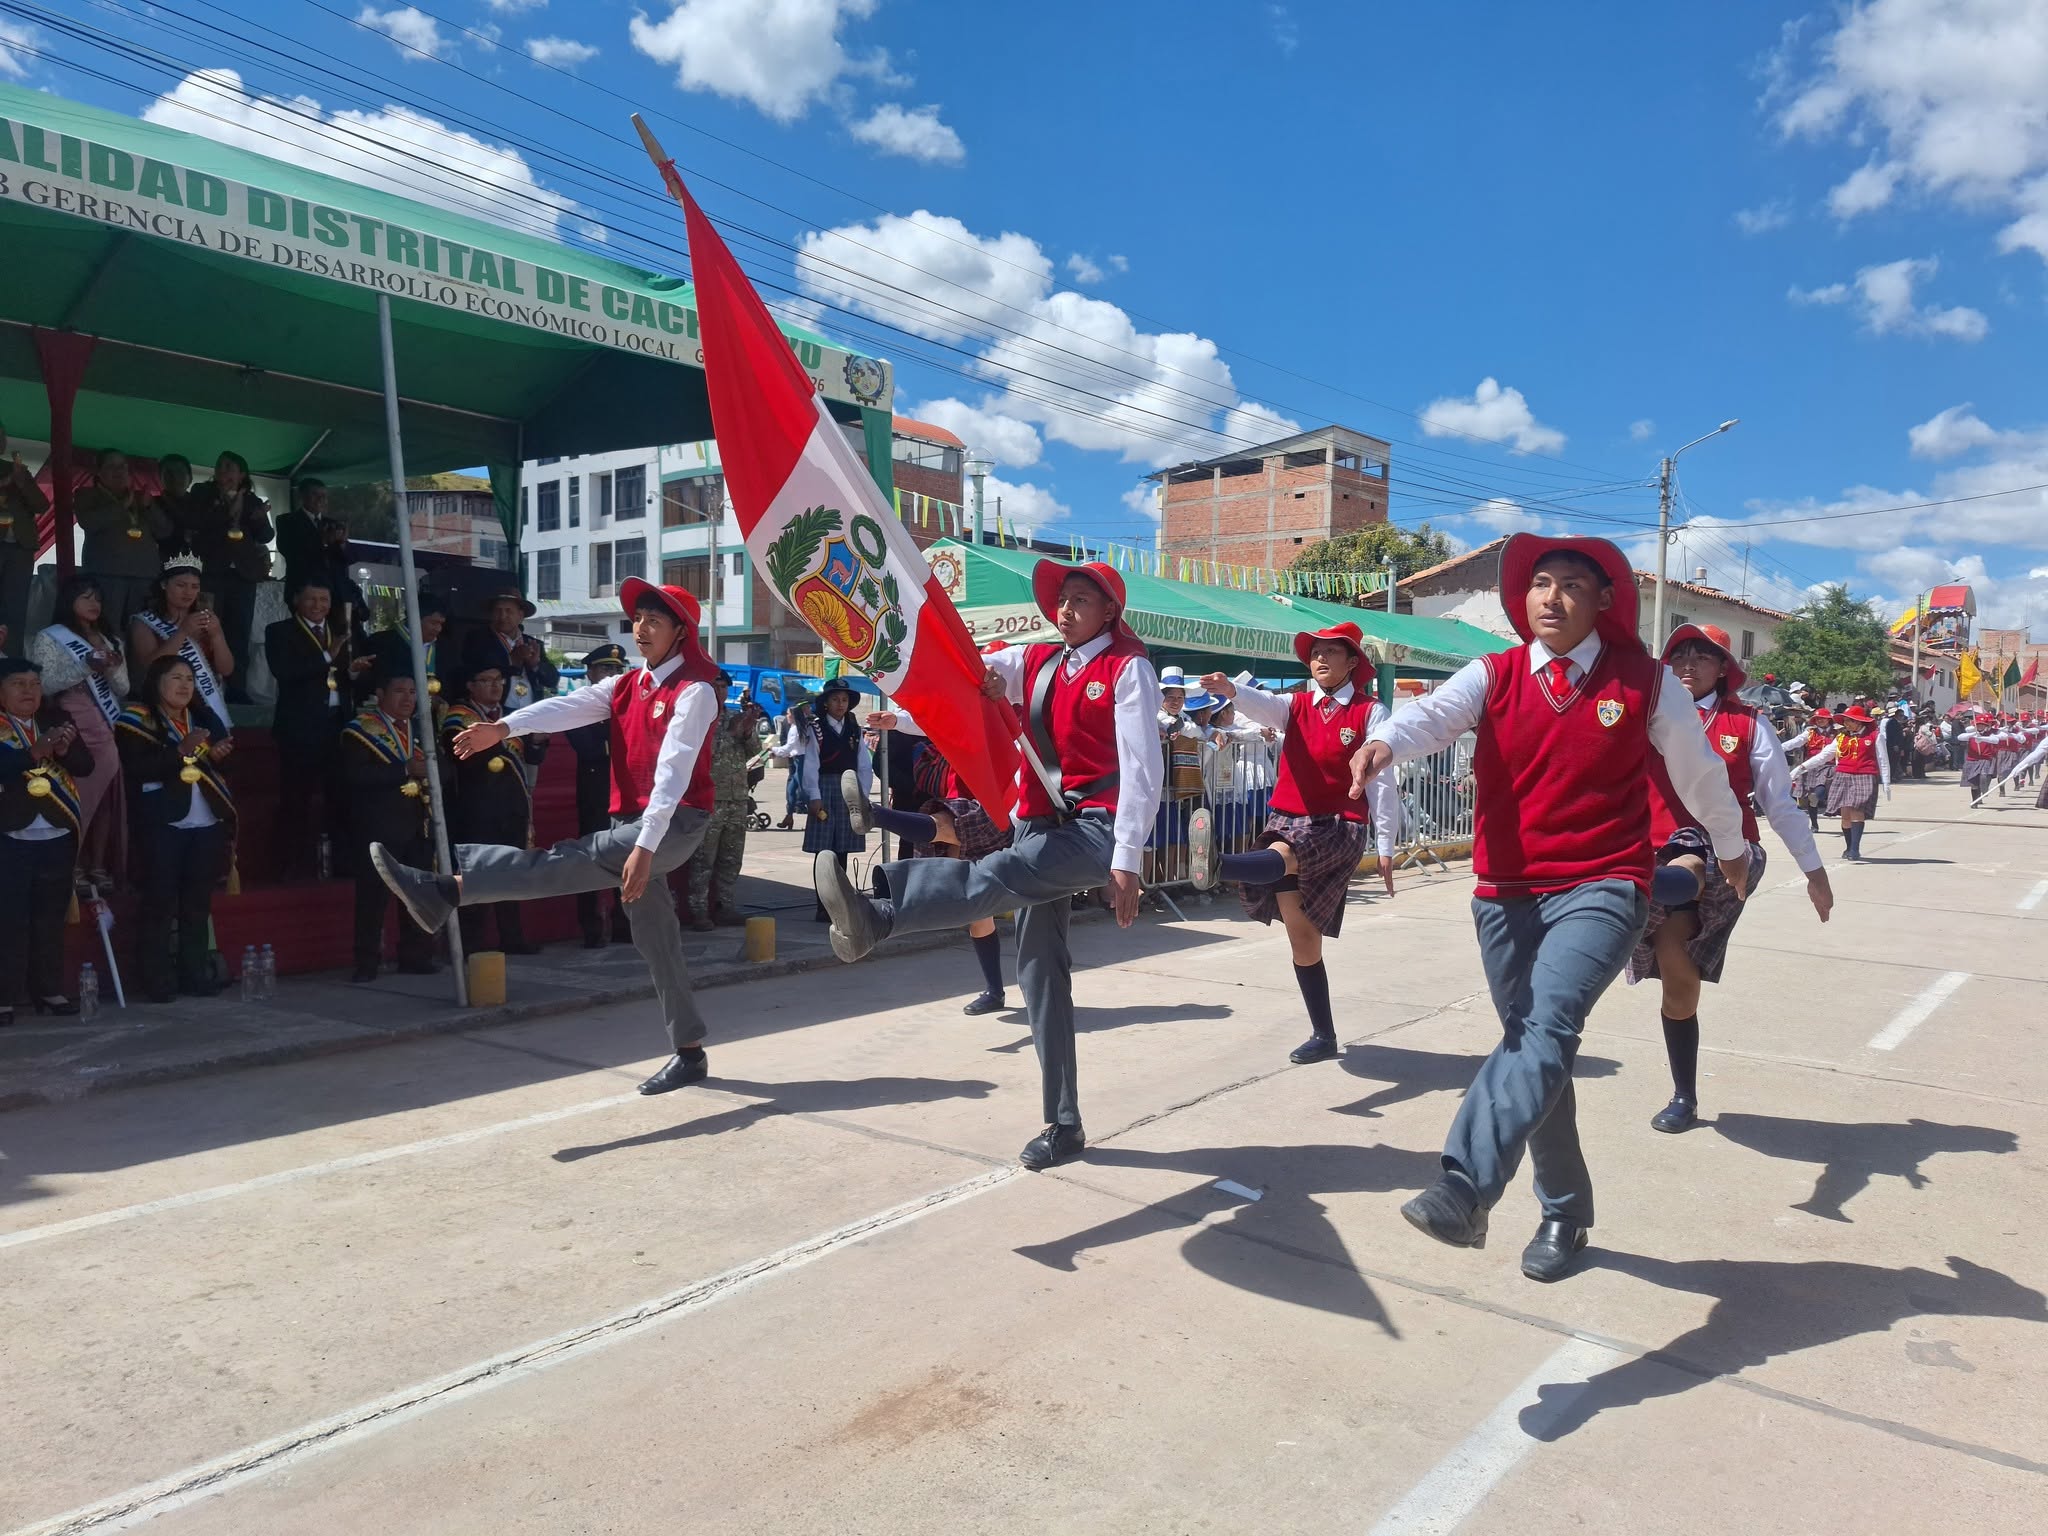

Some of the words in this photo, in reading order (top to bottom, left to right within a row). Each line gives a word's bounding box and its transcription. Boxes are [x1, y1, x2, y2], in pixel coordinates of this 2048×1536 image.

[23, 180, 209, 246] GERENCIA
[218, 228, 262, 260] DE
[272, 242, 457, 305] DESARROLLO
[465, 291, 607, 342] ECONÓMICO
[613, 329, 680, 361] LOCAL
[248, 186, 524, 296] DISTRITAL
[536, 265, 590, 313] DE
[994, 615, 1042, 634] 2026
[1125, 609, 1233, 647] MUNICIPALIDAD
[1235, 626, 1291, 653] DISTRITAL
[91, 671, 120, 721] SIMPATI
